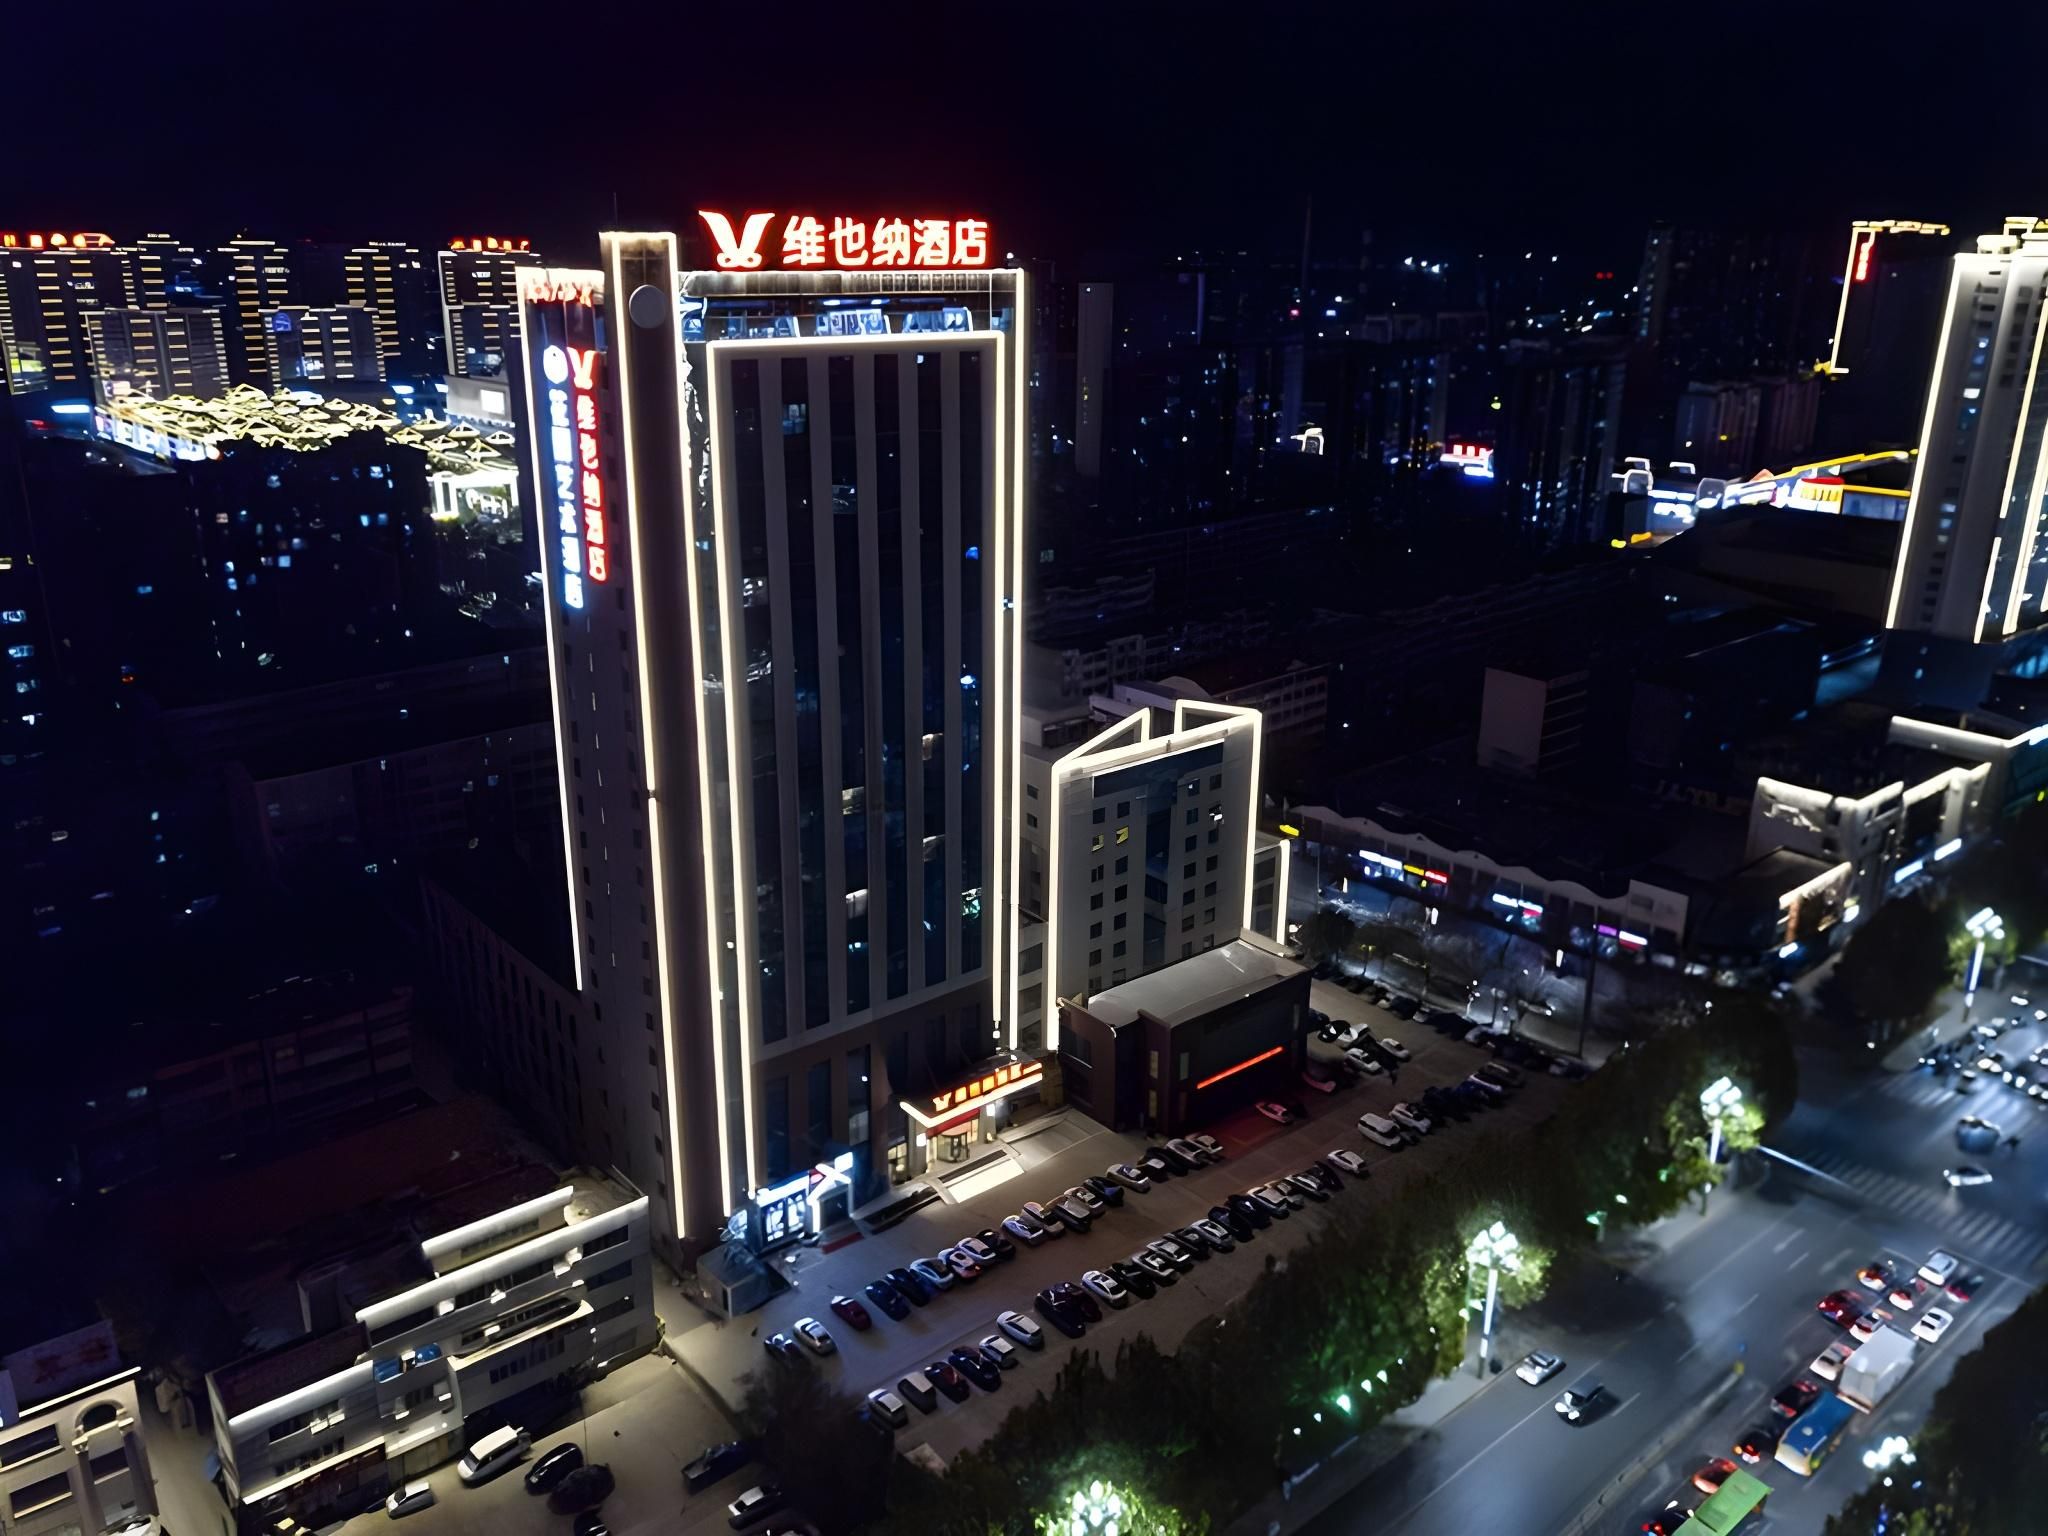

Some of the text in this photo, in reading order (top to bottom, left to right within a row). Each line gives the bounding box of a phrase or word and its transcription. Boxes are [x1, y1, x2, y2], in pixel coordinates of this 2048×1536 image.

[782, 215, 988, 266] 维也纳酒店
